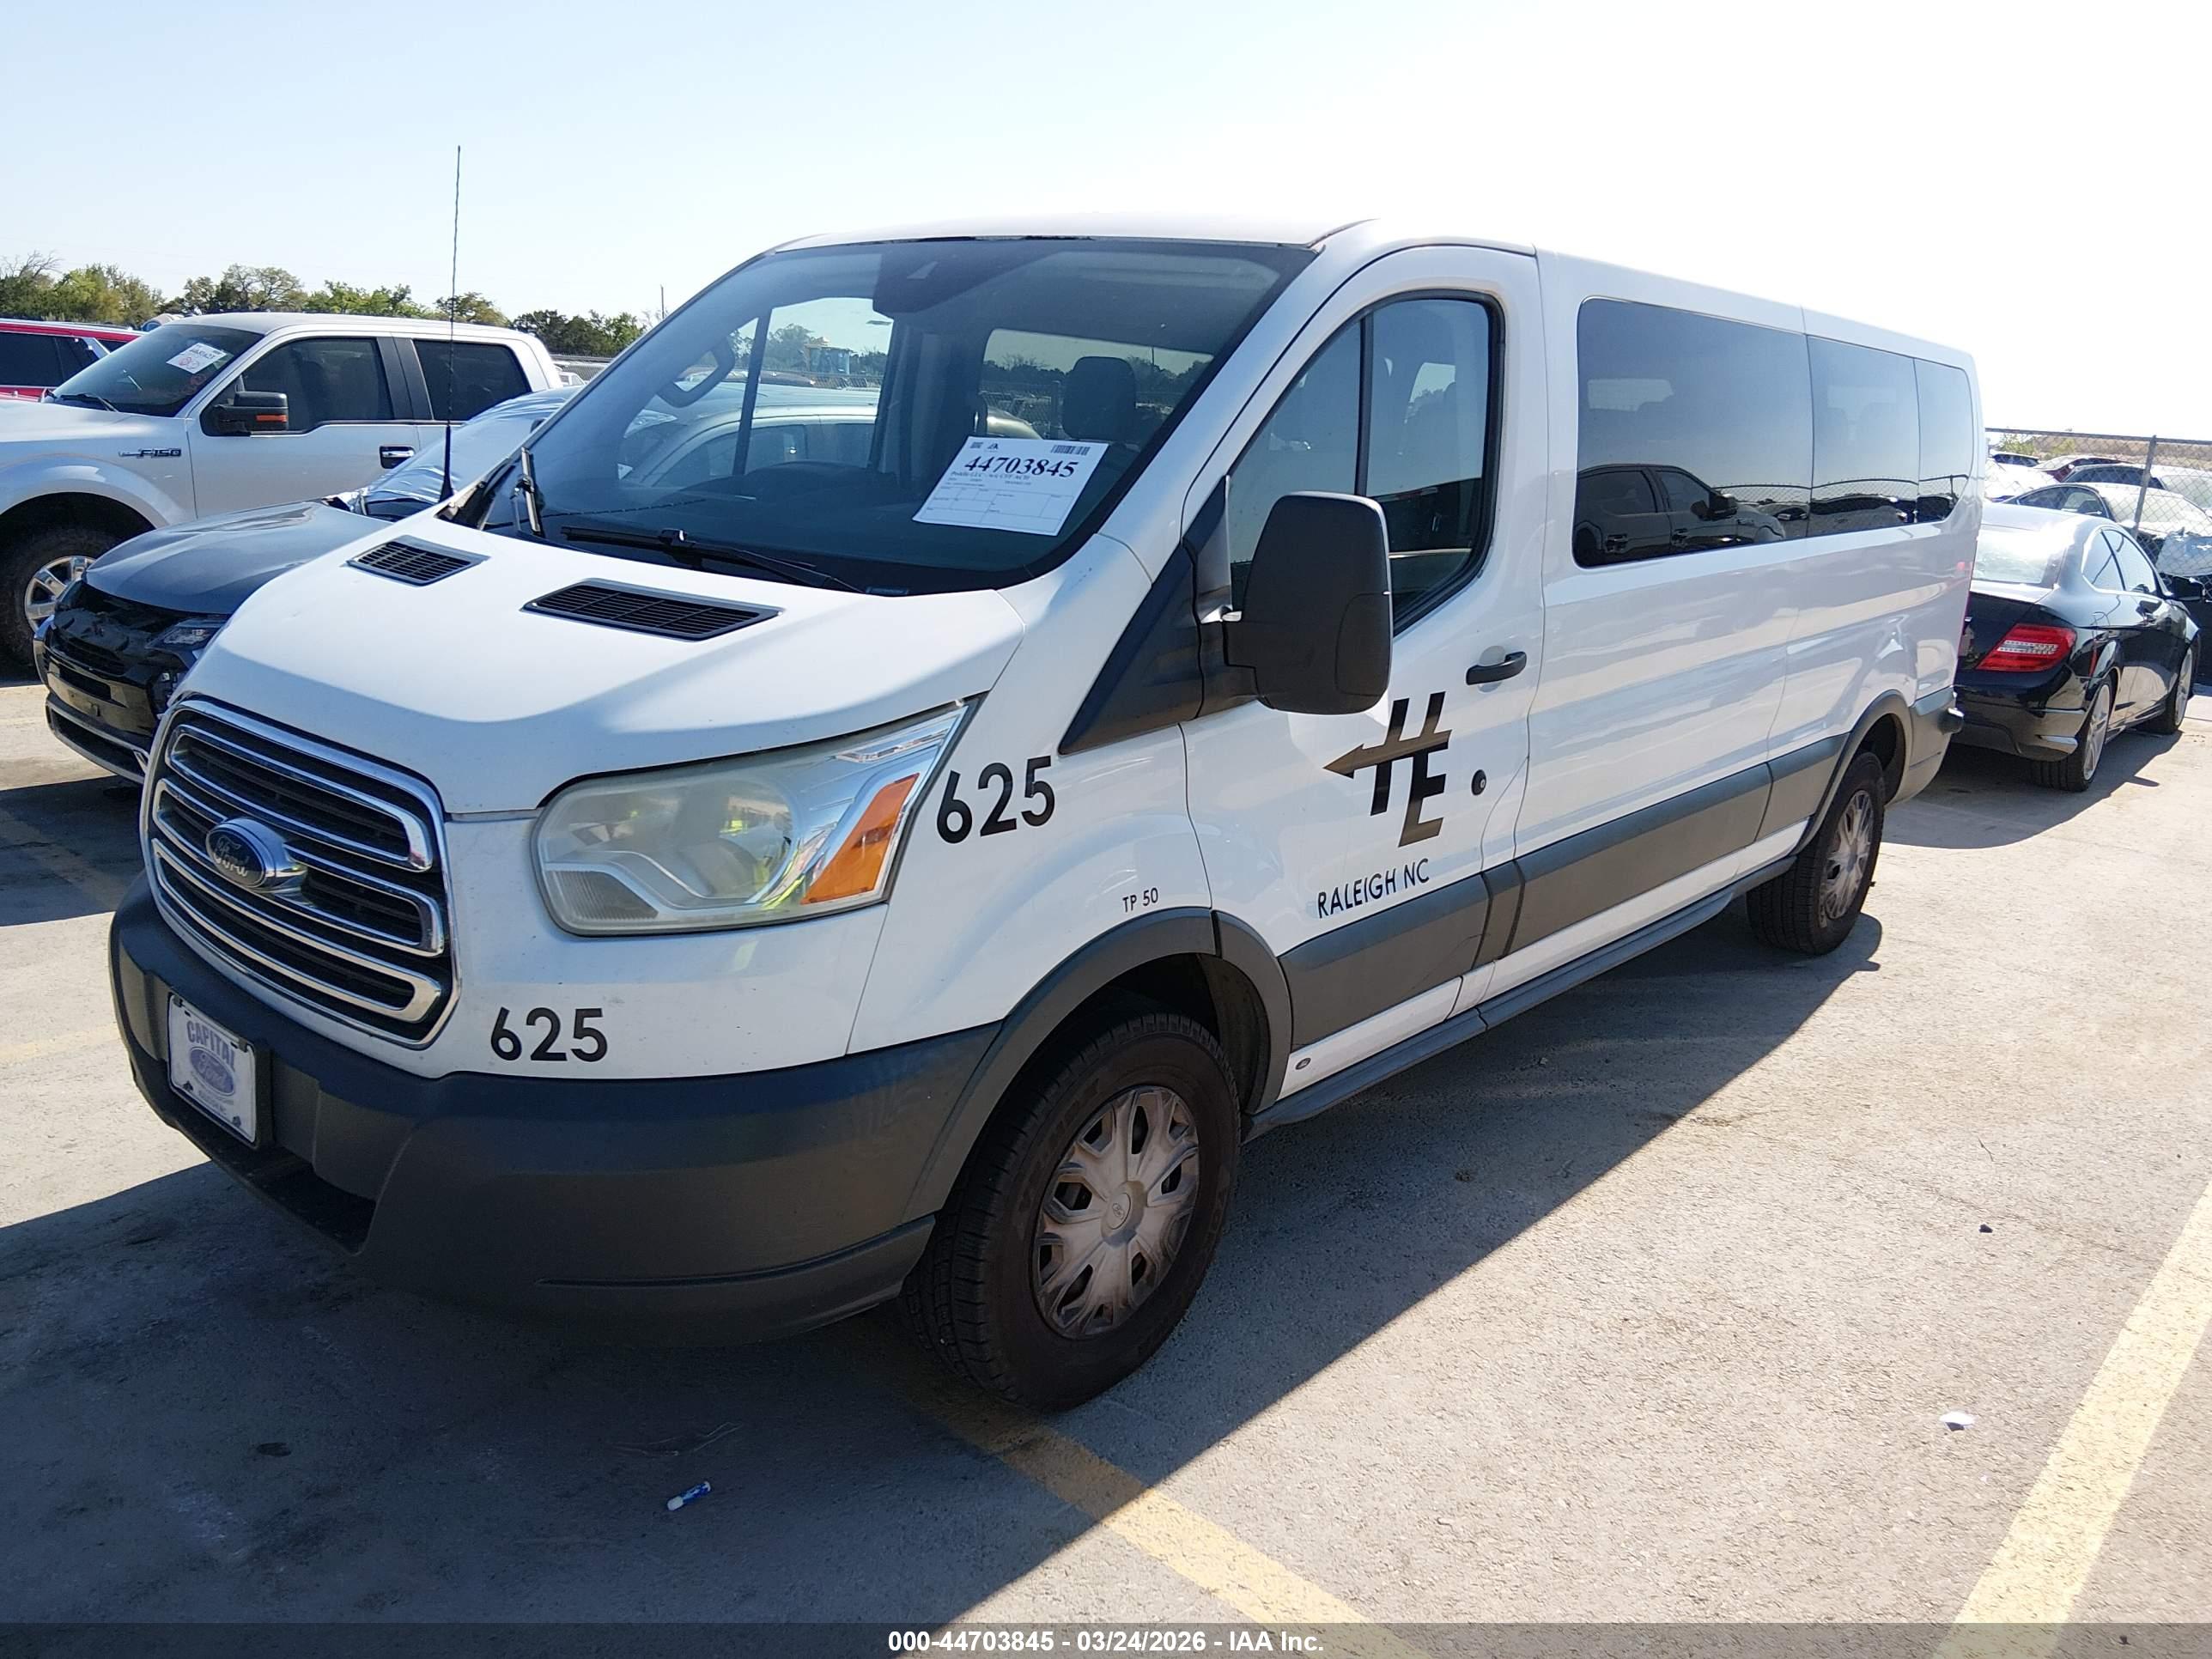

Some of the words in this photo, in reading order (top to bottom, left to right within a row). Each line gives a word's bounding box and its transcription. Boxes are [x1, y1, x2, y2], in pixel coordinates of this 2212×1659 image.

[964, 455, 1079, 478] 44703845
[937, 756, 1055, 844] 625
[213, 836, 249, 878] Ford
[1122, 895, 1137, 913] TP
[1143, 887, 1159, 907] 50
[1317, 872, 1397, 919] RALEIGH
[1403, 859, 1430, 890] NC
[186, 1020, 235, 1073] CAPITAL
[490, 1006, 608, 1062] 625
